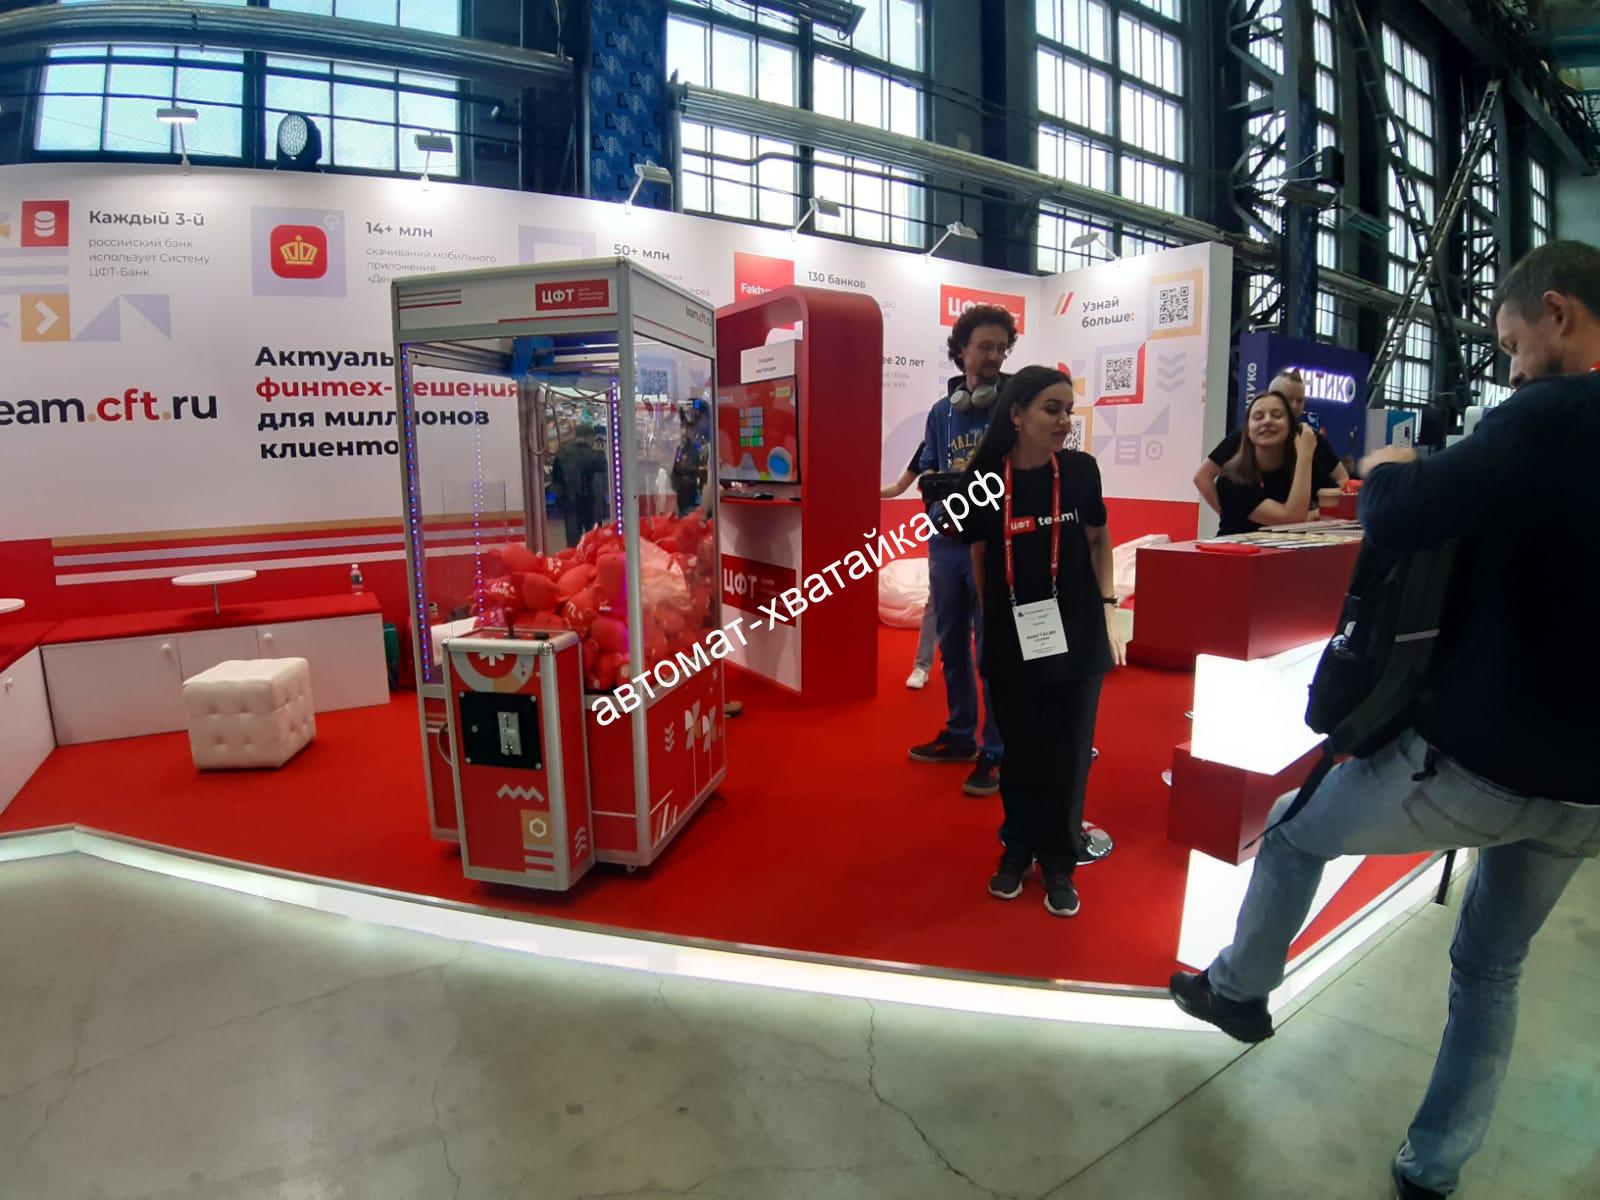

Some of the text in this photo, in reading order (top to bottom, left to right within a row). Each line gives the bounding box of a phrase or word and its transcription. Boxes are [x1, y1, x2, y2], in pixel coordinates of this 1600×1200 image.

[89, 210, 204, 226] Каждый 3-й
[366, 221, 432, 238] 14+ млн
[88, 238, 193, 249] российский банк
[89, 254, 210, 265] использует Систему
[366, 248, 497, 263] скачиваний мобильного
[614, 244, 670, 261] 50+ млн
[89, 267, 150, 278] ЦФТ-Банк
[367, 261, 436, 271] приложения
[808, 271, 866, 289] 130 банков
[542, 289, 575, 305] ЦФТ
[1082, 296, 1119, 312] Узнай
[1082, 312, 1135, 328] больше:
[895, 356, 907, 366] 20
[909, 359, 926, 367] лет
[255, 377, 519, 402] финтех-ешения
[258, 409, 489, 431] для миллонов
[1010, 519, 1031, 531] ЦФТ
[723, 568, 758, 598] ЦФТ
